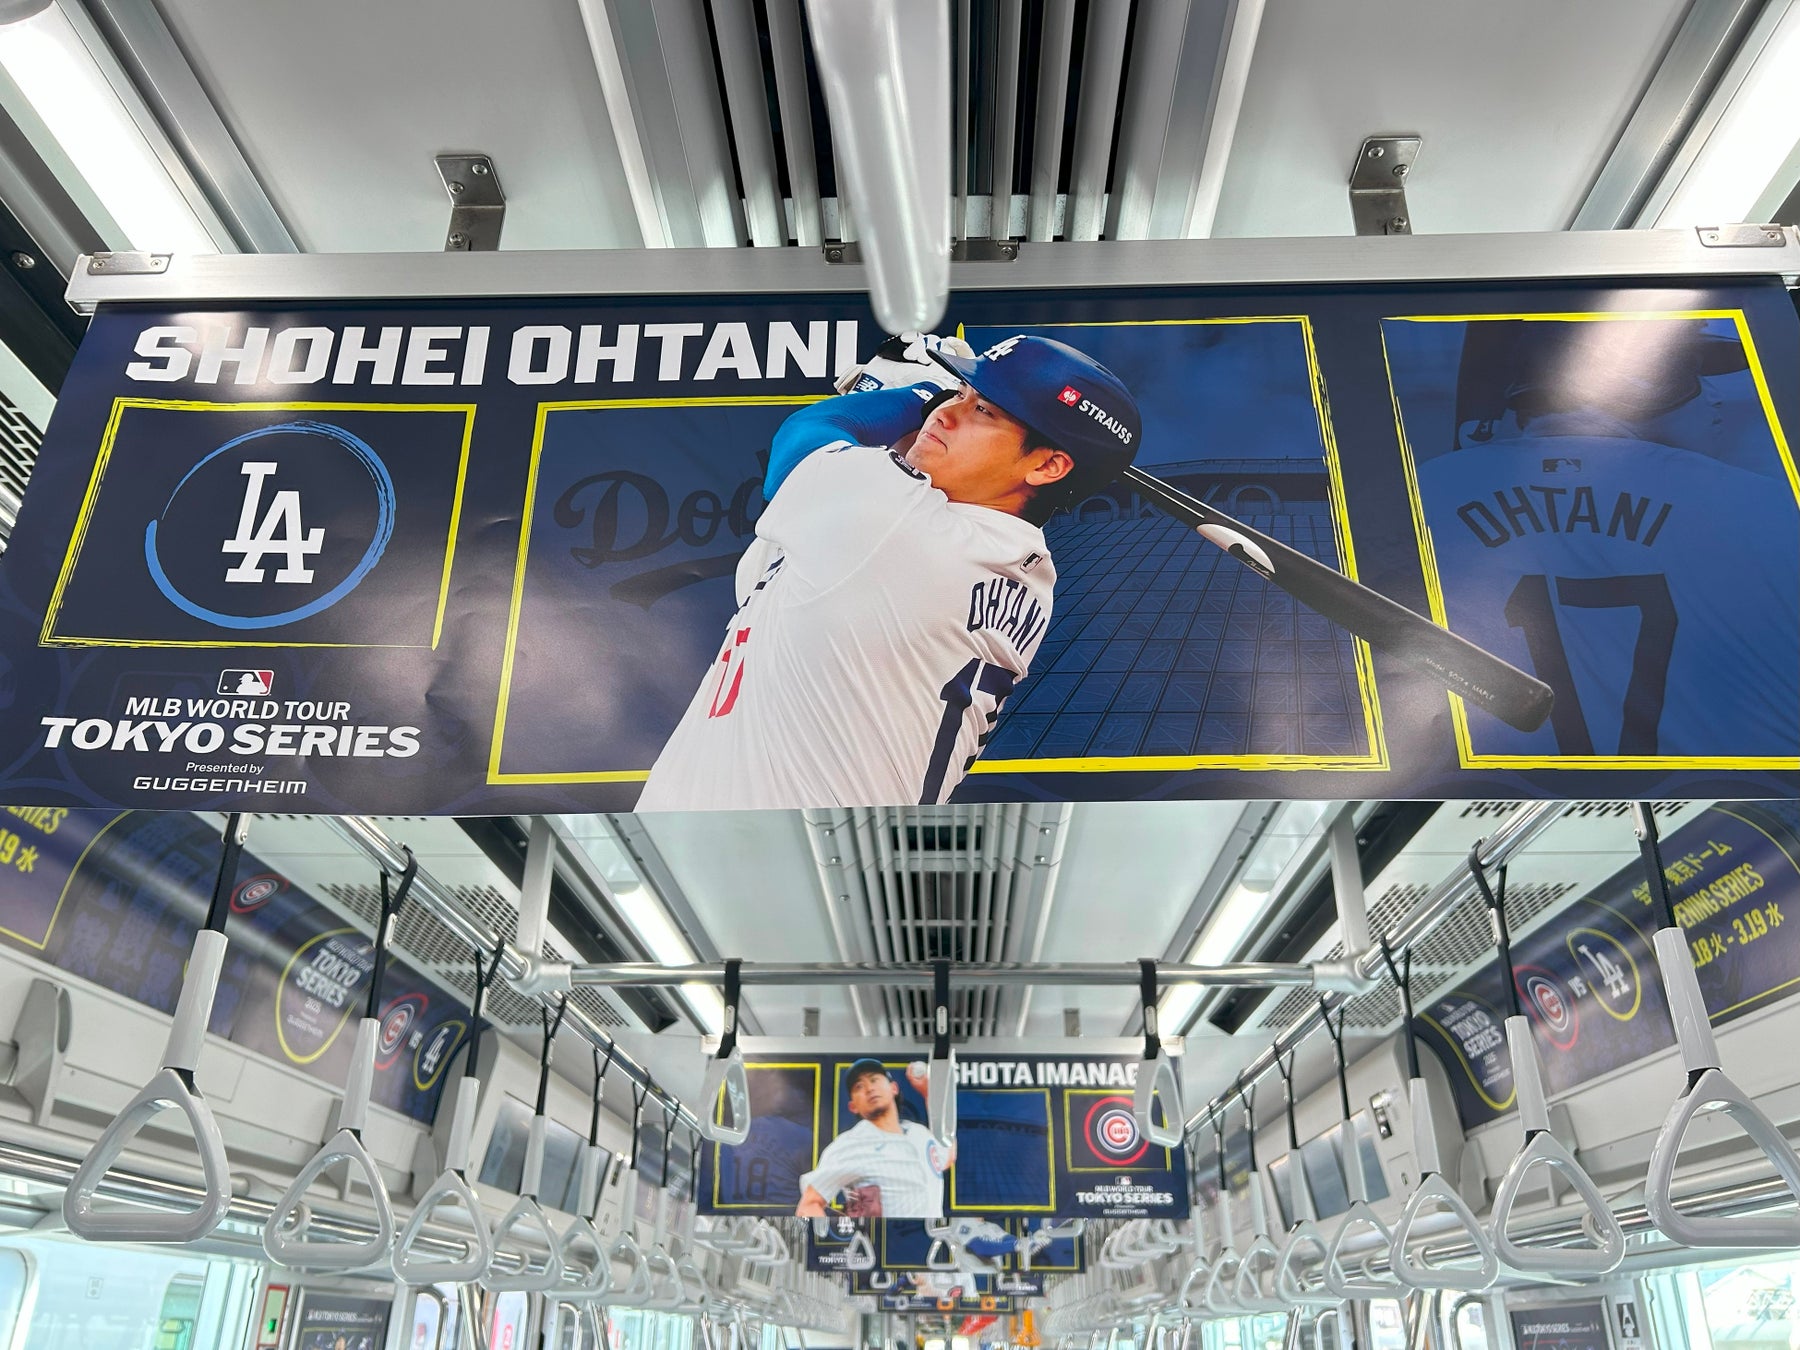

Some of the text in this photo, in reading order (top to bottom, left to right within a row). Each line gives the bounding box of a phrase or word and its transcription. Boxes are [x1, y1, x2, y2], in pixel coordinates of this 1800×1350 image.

[125, 320, 858, 386] SHOHEI OHTANI
[1078, 400, 1133, 445] STRAUSS
[221, 462, 325, 583] LA
[1457, 485, 1672, 548] OHTANI
[967, 577, 1045, 655] OHTANI
[1504, 573, 1679, 756] 17
[125, 697, 351, 721] MLB WORLD TOUR
[40, 716, 422, 758] TOKYO SERIES
[133, 776, 307, 794] GUGGENHEIM
[185, 762, 264, 775] Presented by
[16, 845, 39, 873] 水
[1664, 840, 1733, 886] 東京ドーム
[1709, 862, 1765, 907] SERIES
[1732, 908, 1768, 945] 3.19
[1765, 901, 1784, 928] 水
[296, 966, 348, 1008] SERIES
[312, 948, 361, 988] TOKYO
[1463, 1025, 1504, 1059] SERIES
[733, 1154, 769, 1201] 18
[1076, 1192, 1174, 1204] TOKYO SERIES
